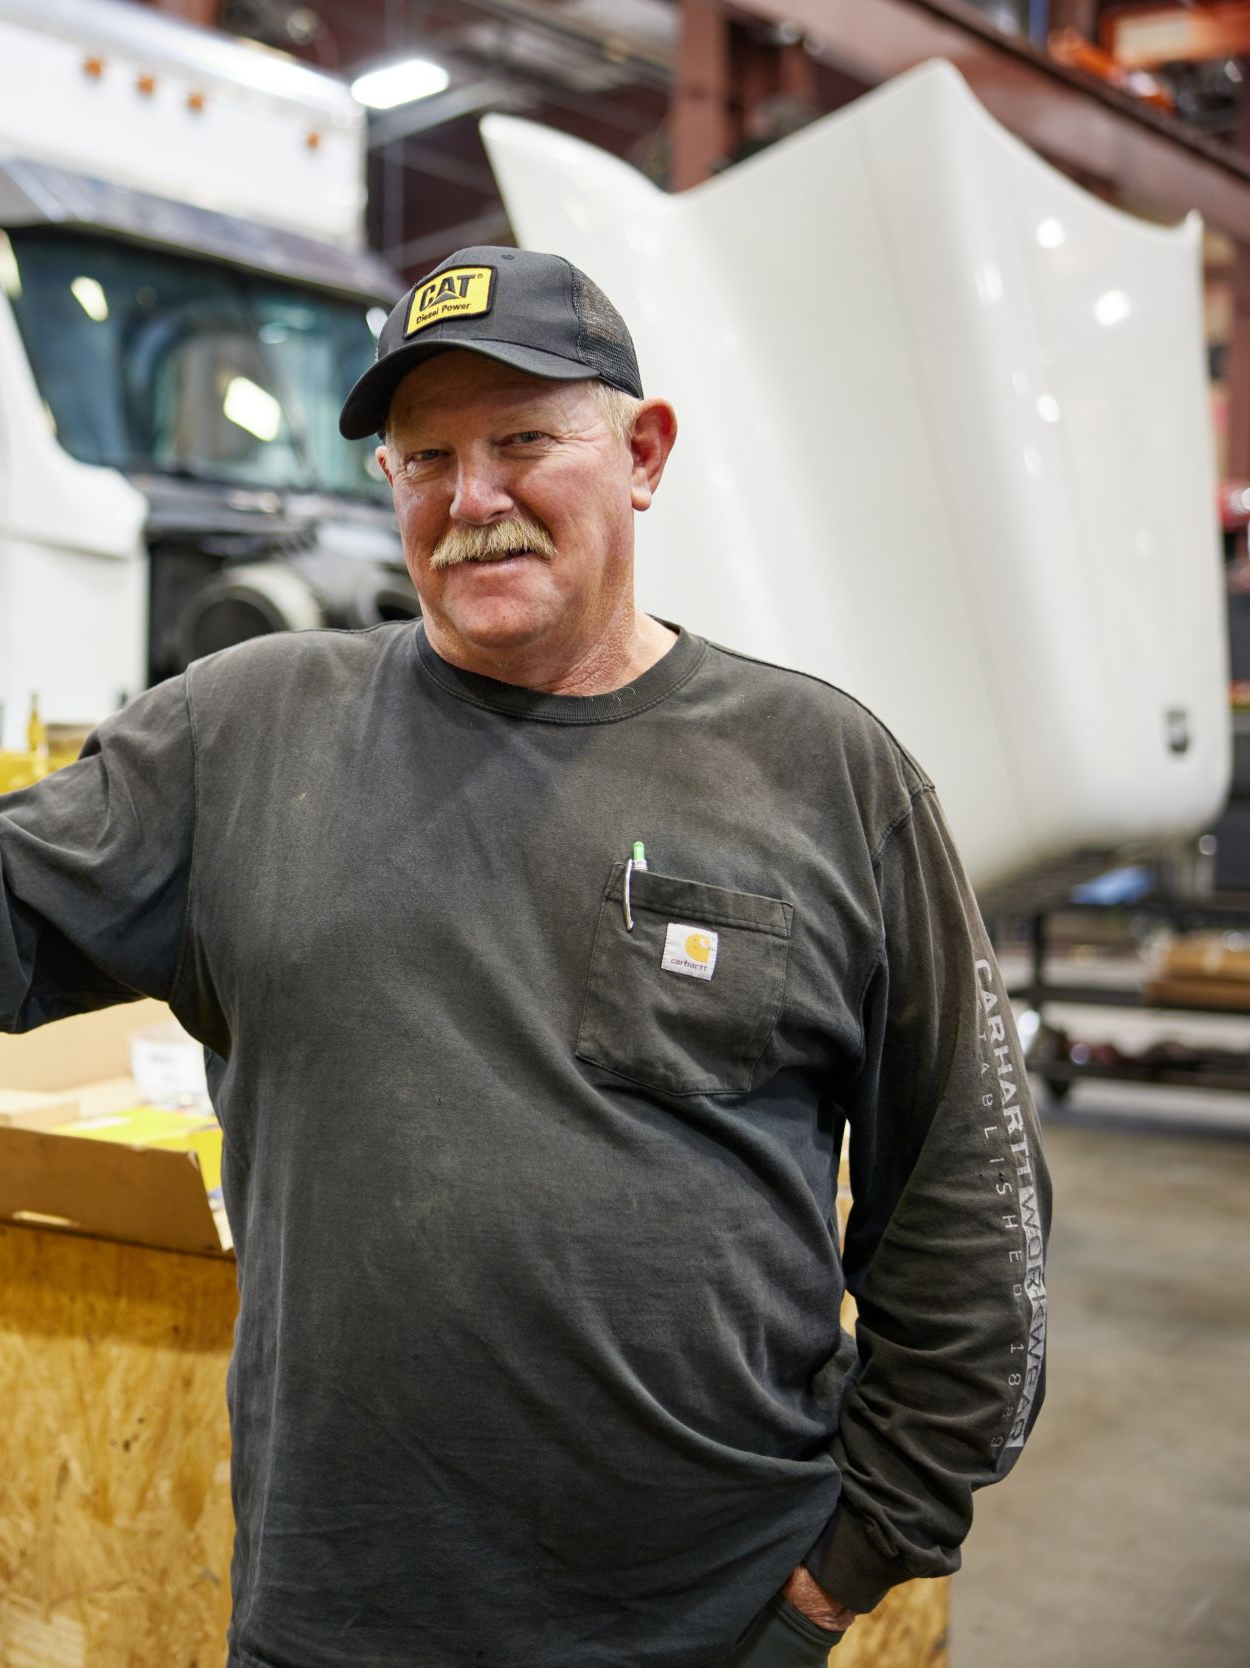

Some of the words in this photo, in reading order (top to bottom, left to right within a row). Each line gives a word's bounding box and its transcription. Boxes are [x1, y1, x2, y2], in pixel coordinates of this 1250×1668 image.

[419, 274, 476, 312] CAT
[416, 308, 440, 324] Diesel
[442, 303, 470, 313] Power
[670, 958, 708, 972] carhartt
[974, 958, 1033, 1181] CARHARTT
[1010, 1191, 1046, 1442] WORKWEAR
